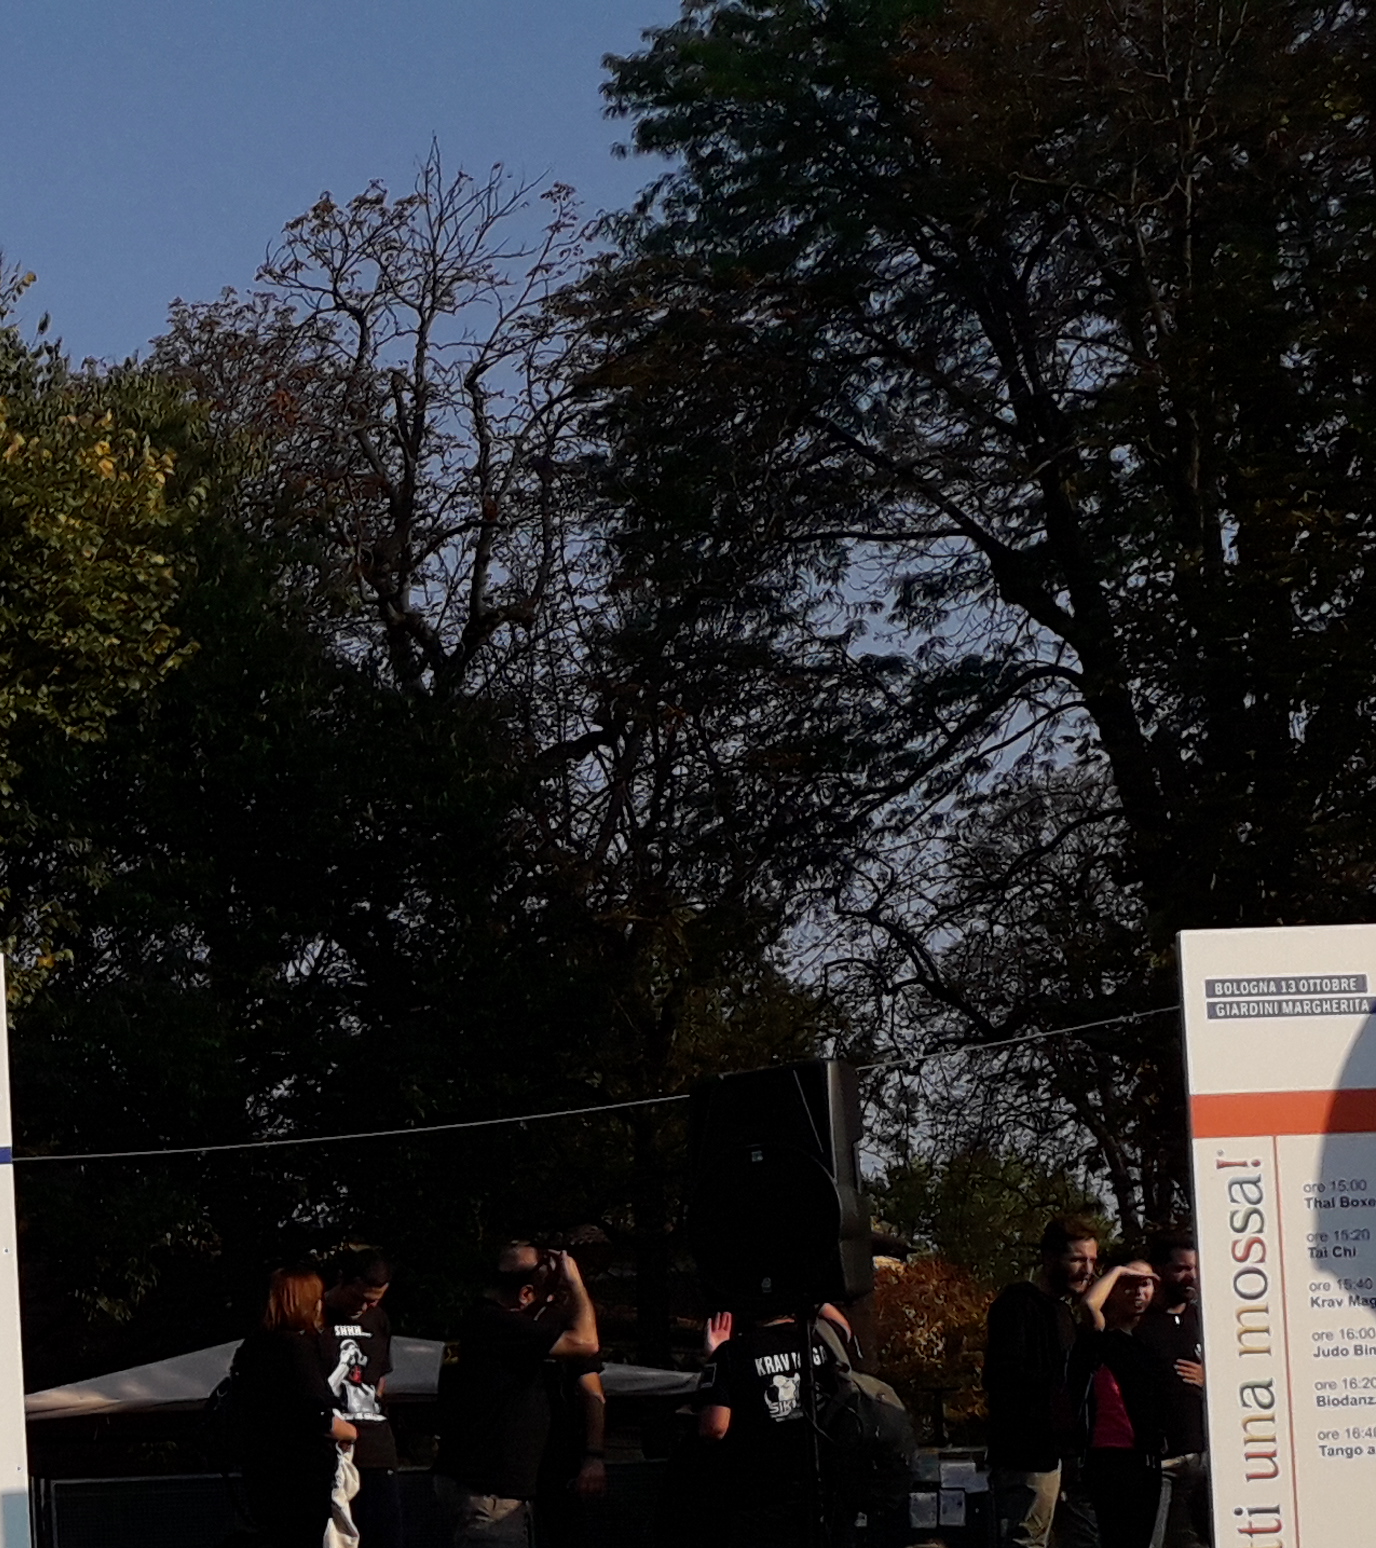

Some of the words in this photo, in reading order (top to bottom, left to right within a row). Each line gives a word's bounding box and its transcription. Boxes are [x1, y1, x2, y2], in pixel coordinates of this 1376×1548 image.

[1214, 981, 1277, 995] BOLOGNA
[1280, 979, 1296, 993] 13
[1298, 978, 1357, 992] OTTOBRE
[1215, 1001, 1278, 1017] GIARDINI
[1281, 999, 1369, 1015] MARGHERITA
[1303, 1183, 1326, 1193] ore
[1304, 1196, 1335, 1209] Thai
[1216, 1158, 1272, 1357] mossa!
[1308, 1246, 1328, 1259] Tai
[1332, 1246, 1356, 1258] Chi
[1309, 1281, 1331, 1292] ore
[1310, 1296, 1343, 1308] Krav
[1312, 1331, 1334, 1341] ore
[1313, 1345, 1349, 1358] Judo
[755, 1354, 790, 1377] KRAV
[1315, 1381, 1337, 1391] ore
[1239, 1378, 1279, 1482] una
[1318, 1430, 1339, 1440] ore
[1319, 1445, 1363, 1459] Tango
